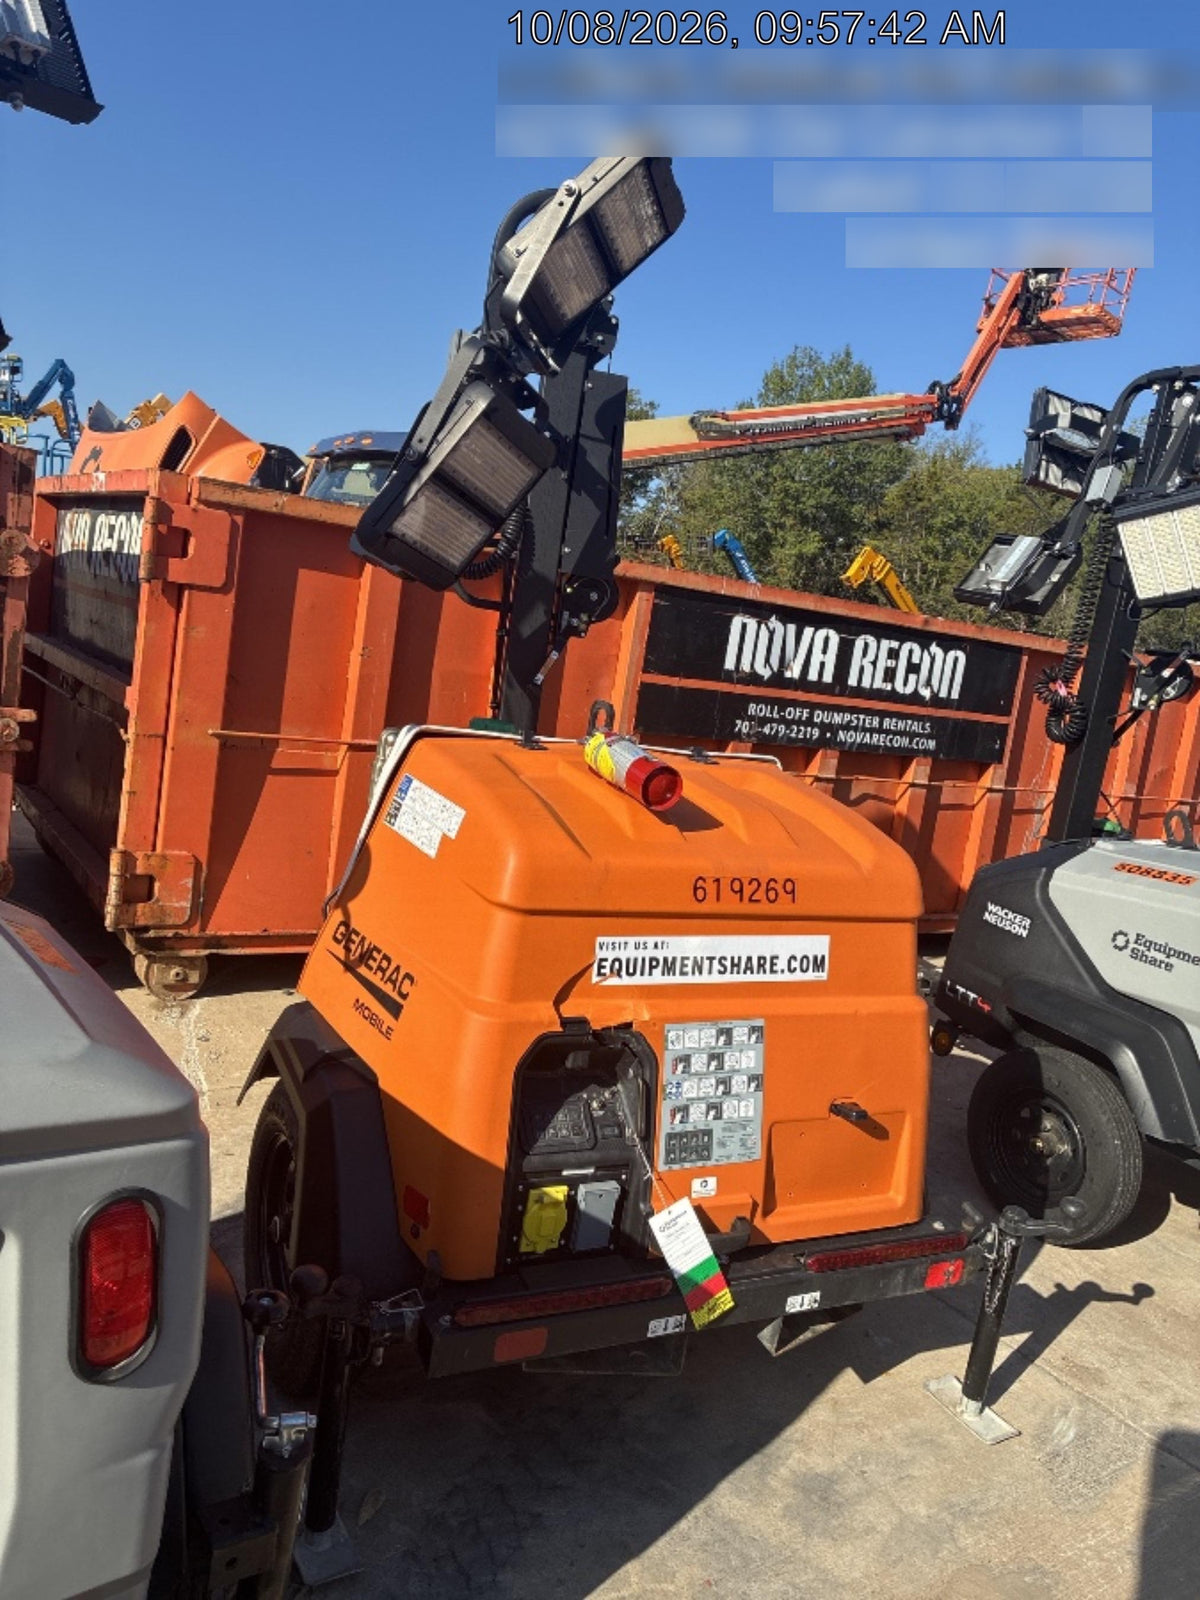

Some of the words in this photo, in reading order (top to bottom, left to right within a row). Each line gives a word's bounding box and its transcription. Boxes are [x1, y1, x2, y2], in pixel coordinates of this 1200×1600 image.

[723, 614, 840, 684] NOVA
[847, 633, 967, 701] RECON
[747, 703, 810, 722] ROLL-OFF
[814, 710, 880, 729] DUMPSTER
[883, 717, 932, 734] RENTALS
[734, 719, 820, 741] 70-479-2219
[836, 729, 937, 751] NOVARECON.COM
[692, 875, 797, 904] 619269
[982, 911, 1029, 938] NEUSON
[987, 901, 1032, 929] WACKER
[332, 920, 415, 1002] GENERAC
[598, 941, 629, 952] VISIT
[634, 941, 648, 951] US
[1129, 946, 1175, 973] Share
[596, 954, 827, 979] EQUIPMENTSHARE.COM
[352, 998, 395, 1041] MOBILE
